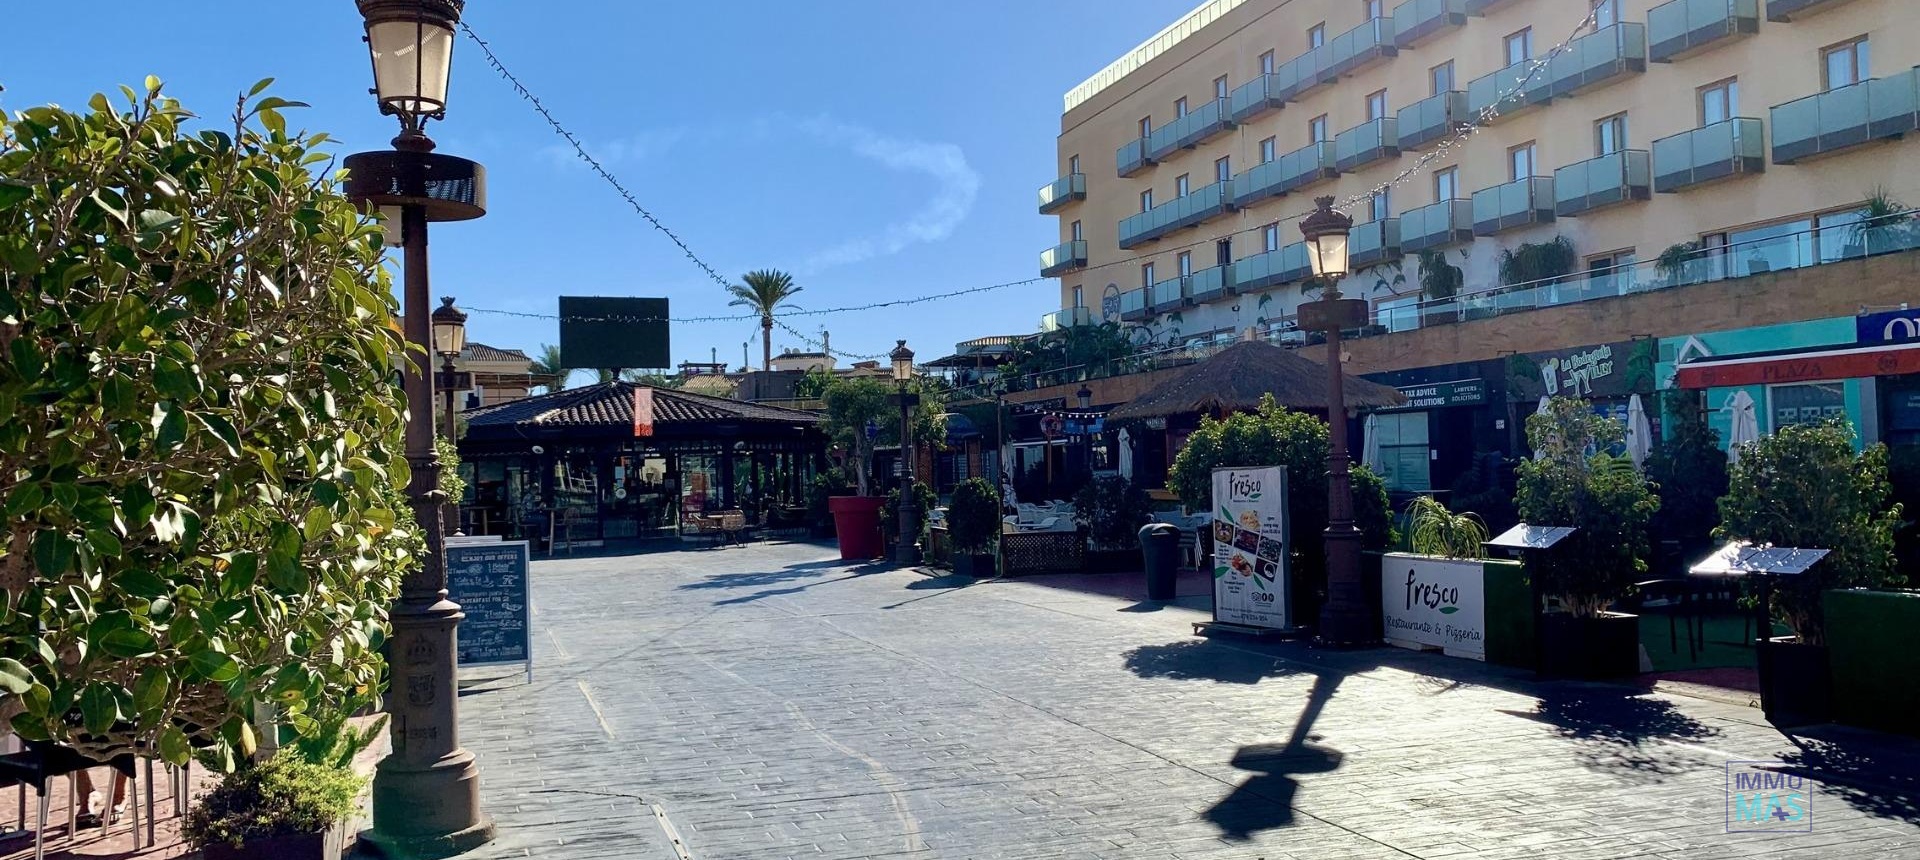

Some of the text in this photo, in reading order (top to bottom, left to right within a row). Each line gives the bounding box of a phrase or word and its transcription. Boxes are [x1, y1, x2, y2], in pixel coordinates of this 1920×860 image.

[1571, 344, 1612, 370] Bodeguita
[1763, 363, 1823, 380] PLAZA
[1405, 387, 1437, 398] TAX ADVICE
[1413, 397, 1445, 407] SOLUTIONS
[1451, 394, 1481, 402] SOLICITORS
[1230, 472, 1261, 500] fresco
[1405, 569, 1458, 611] fresco
[1386, 615, 1432, 634] Restaurante
[1446, 624, 1482, 642] Pizzeria
